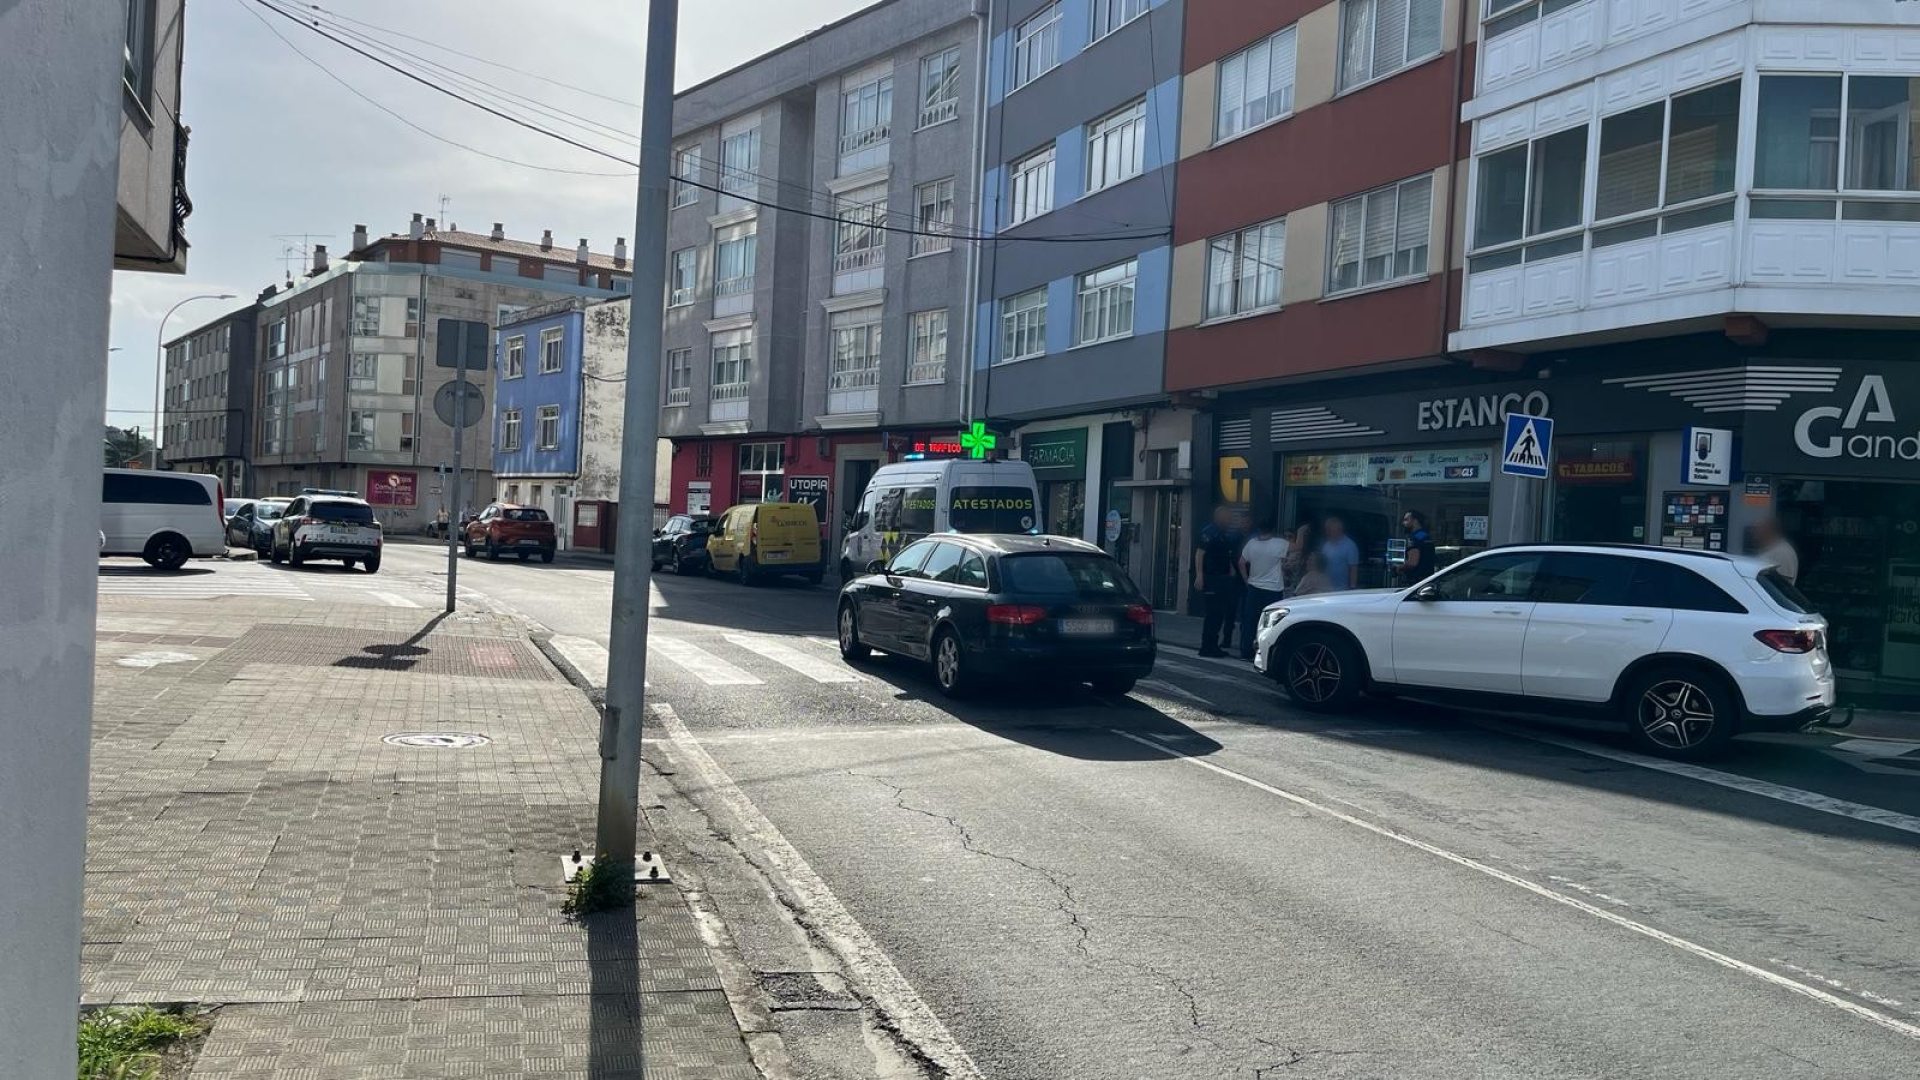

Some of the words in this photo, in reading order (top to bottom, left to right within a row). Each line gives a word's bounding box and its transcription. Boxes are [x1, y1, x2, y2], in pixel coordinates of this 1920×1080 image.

[1418, 390, 1549, 431] ESTANCO
[1029, 446, 1076, 464] FARMACIA
[1573, 462, 1625, 474] TABACOS
[790, 479, 828, 491] UTOPIA
[902, 499, 936, 510] ATESTADOS
[953, 499, 1033, 510] ATESTADOS
